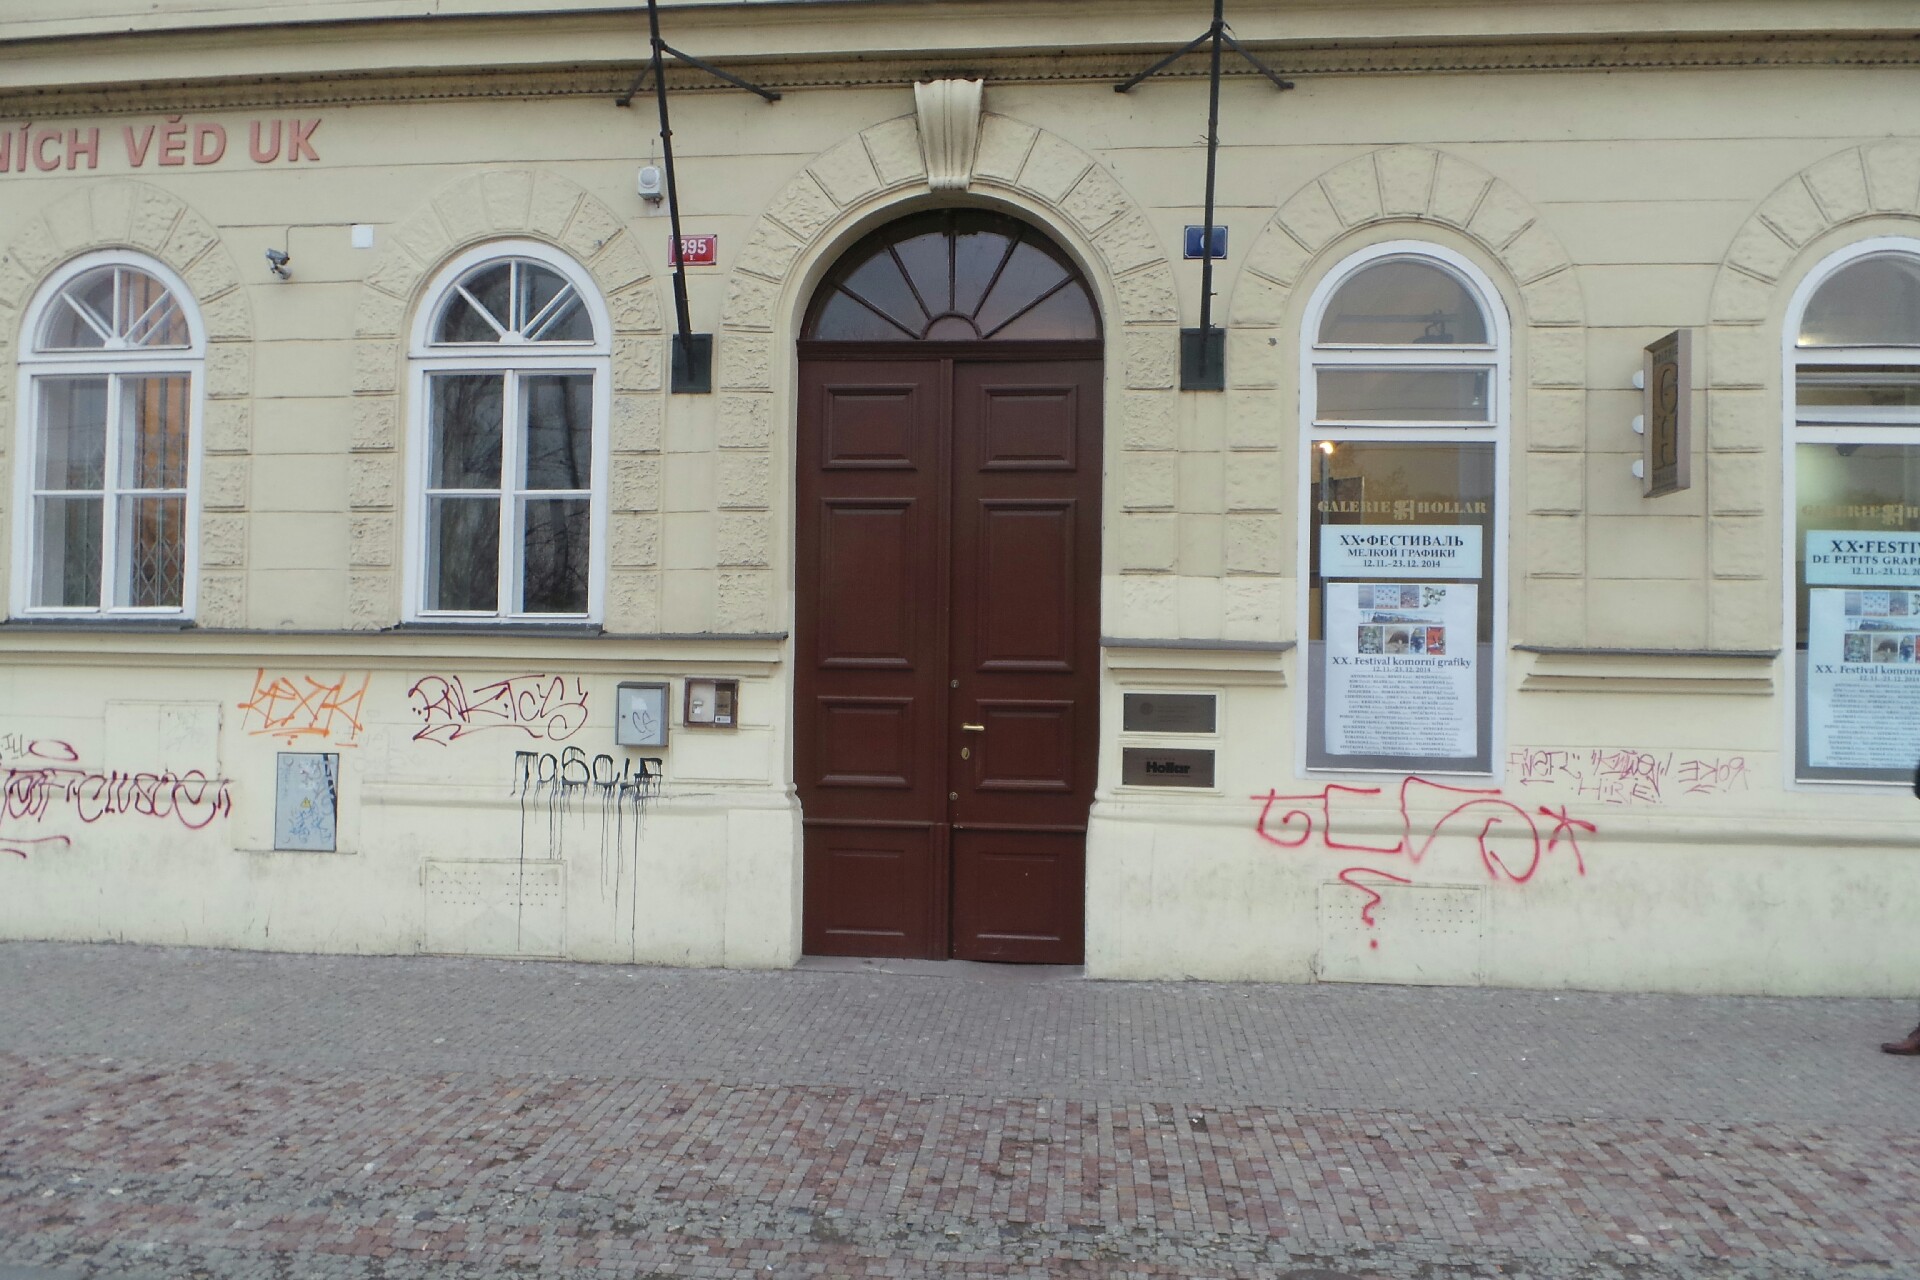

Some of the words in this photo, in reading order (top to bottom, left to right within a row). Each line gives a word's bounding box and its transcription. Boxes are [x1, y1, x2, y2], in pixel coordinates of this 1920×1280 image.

[122, 115, 227, 167] VĚD
[249, 118, 322, 163] UK
[1318, 500, 1391, 512] GALERIE
[1418, 501, 1487, 514] HOLLAR
[1348, 547, 1397, 557] МЕЛКОЙ
[1401, 549, 1456, 557] ГРАФИКИ
[1812, 554, 1831, 564] DE
[1834, 555, 1878, 565] PETITS
[1332, 656, 1352, 665] XX.
[1355, 656, 1391, 666] Festival
[1393, 657, 1435, 667] komorní
[1437, 657, 1471, 669] grafiky
[1840, 665, 1879, 675] Festival
